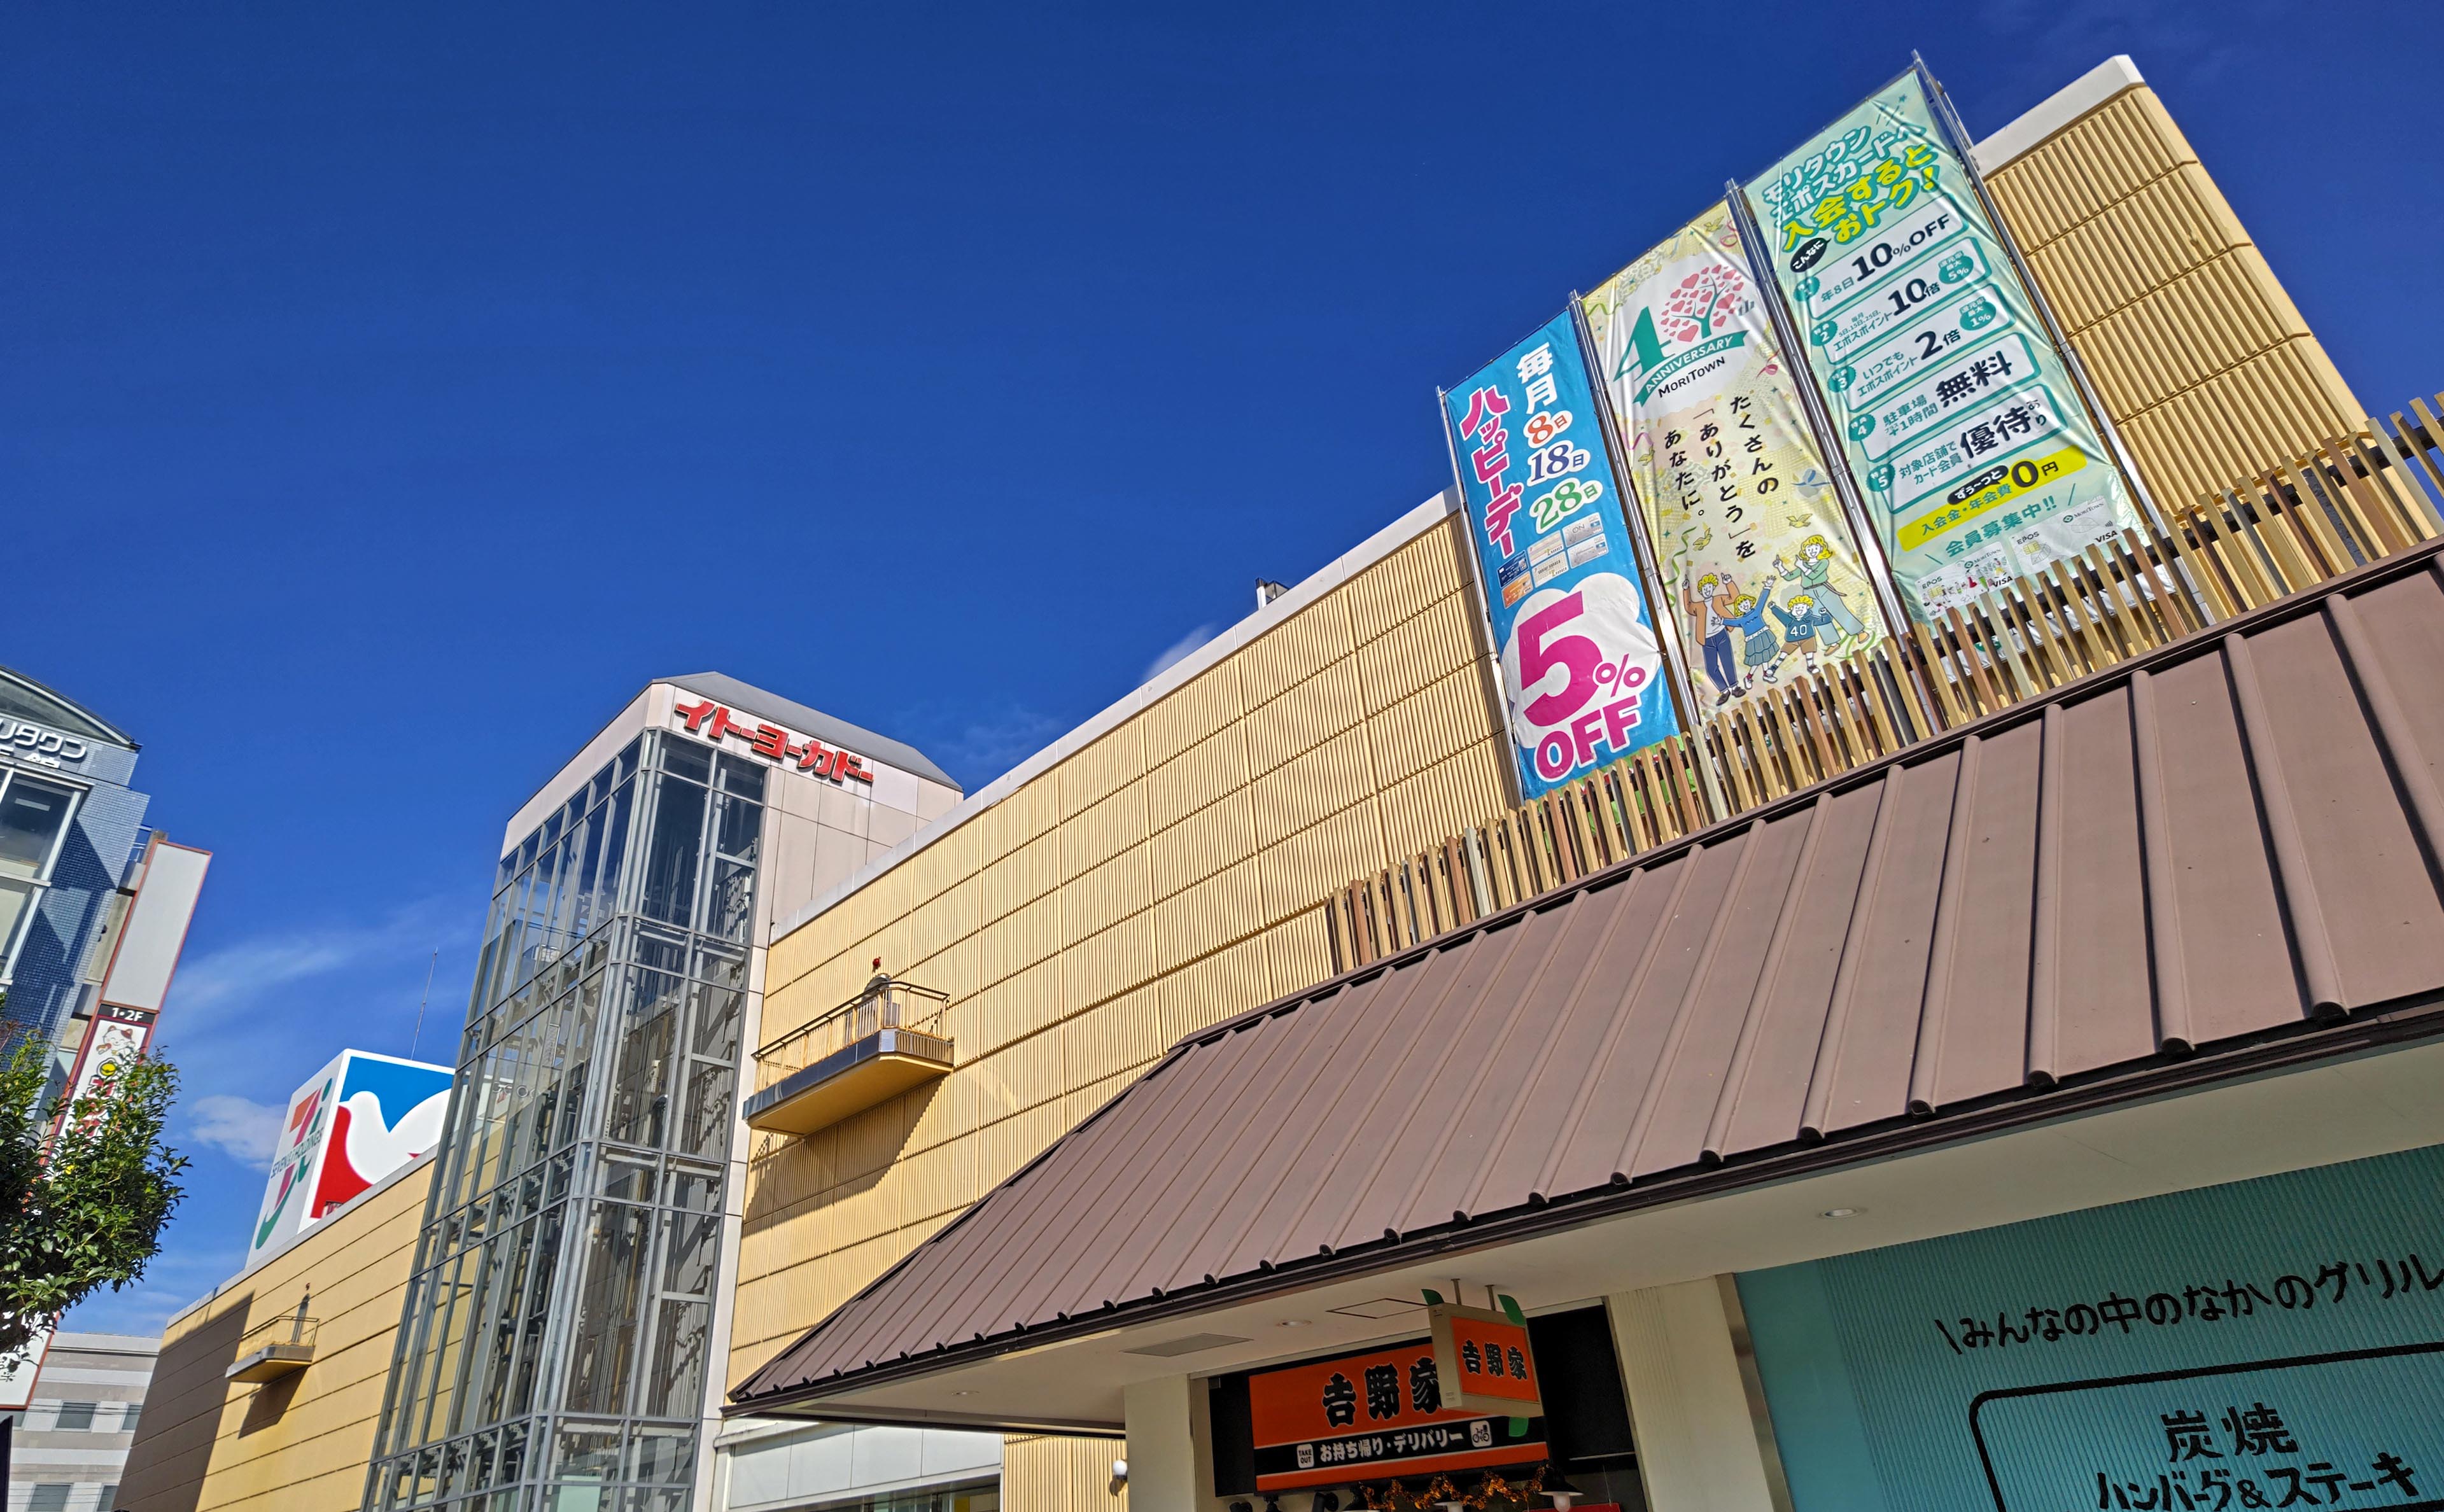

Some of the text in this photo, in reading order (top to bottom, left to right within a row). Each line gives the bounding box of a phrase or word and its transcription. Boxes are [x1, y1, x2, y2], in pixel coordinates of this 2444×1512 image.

[1763, 126, 1869, 204] モリタウン
[1783, 143, 1933, 251] 入会すると
[1792, 239, 1824, 270] こんなに
[1821, 277, 1855, 302] 年8日
[1851, 214, 1949, 281] 10%OFF
[1948, 267, 1969, 281] 5%
[1970, 313, 1991, 327] 1%
[1516, 342, 1557, 415] 毎月
[1645, 335, 1734, 395] ANNIVERSARY
[1857, 328, 1961, 397] エポスポイント 2倍
[1862, 351, 1904, 379] いつでも
[1935, 350, 2012, 408] 無料
[1527, 414, 1568, 445] 8日
[1883, 394, 1927, 425] 駐車場
[1530, 444, 1585, 482] 18日
[1729, 395, 1779, 495] たくさんの
[1899, 441, 1957, 479] 対象店舗で
[1913, 405, 2030, 485] カード会員 優待
[1460, 386, 1522, 557] ハッピーデー
[1664, 429, 1704, 516] あなたに。
[1533, 480, 1599, 529] 28日
[1921, 482, 2012, 536] 入会金・年会費
[2016, 531, 2040, 545] EPOS
[2094, 530, 2118, 543] VISA
[1921, 576, 1943, 590] EPOS
[1993, 575, 2013, 588] VISA
[1790, 624, 1808, 637] 40
[1517, 590, 1646, 727] 5%
[675, 699, 874, 783] イトーヨーカドー
[1536, 695, 1638, 780] OFF
[1462, 1339, 1528, 1380] 吉野家
[1322, 1356, 1443, 1428] 吉野家
[1298, 1449, 1312, 1457] TAKE
[1320, 1429, 1463, 1462] お持ち帰り・デリバリー
[2161, 1402, 2298, 1462] 炭焼
[1300, 1455, 1312, 1464] OUT
